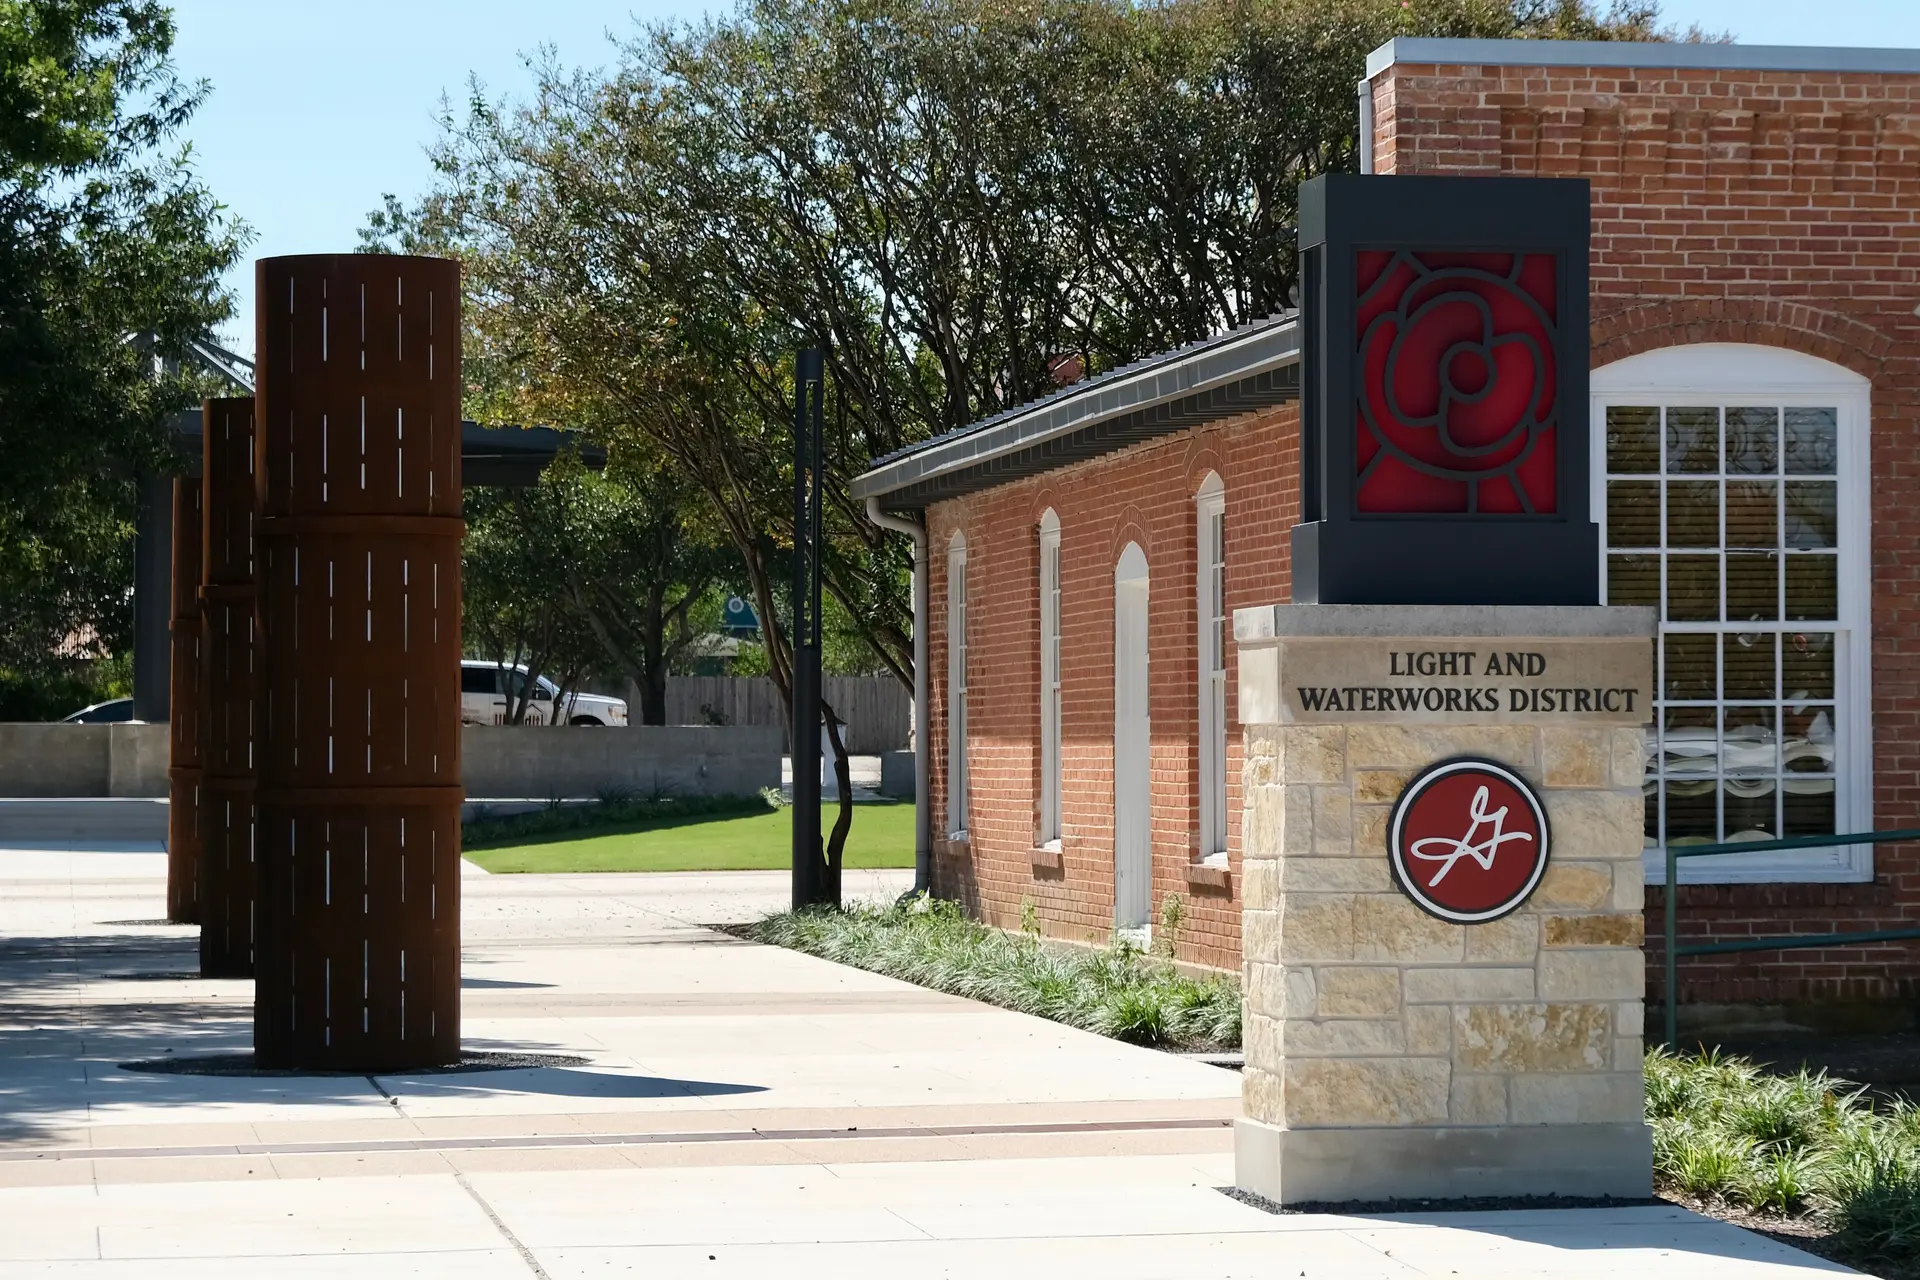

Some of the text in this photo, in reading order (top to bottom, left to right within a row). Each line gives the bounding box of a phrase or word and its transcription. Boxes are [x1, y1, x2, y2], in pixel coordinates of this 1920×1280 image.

[1389, 652, 1546, 677] LIGHT AND
[1297, 687, 1638, 712] WATERWORKS DISTRICT
